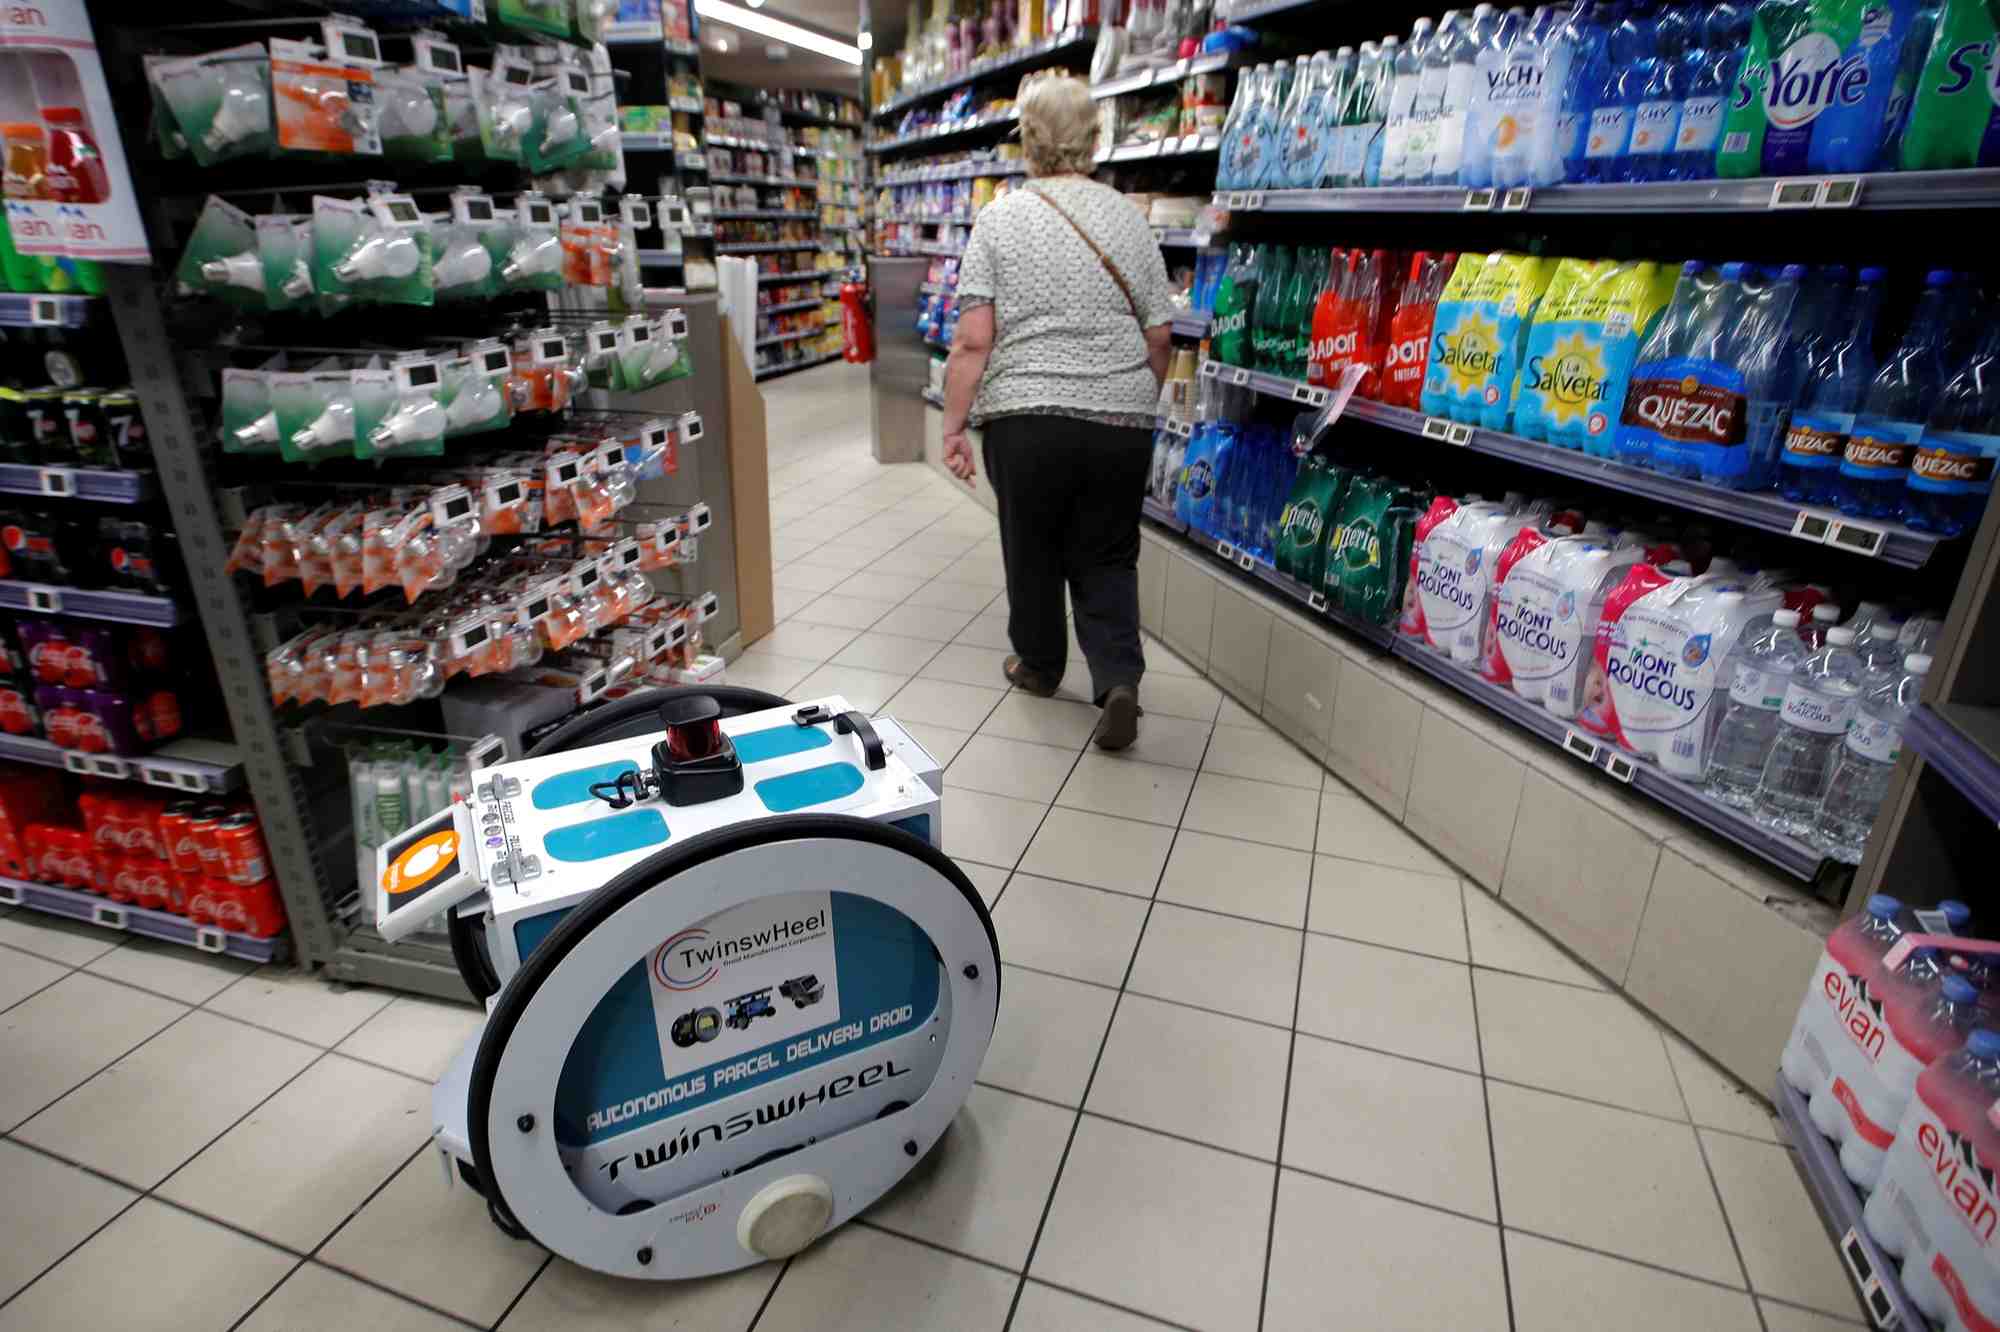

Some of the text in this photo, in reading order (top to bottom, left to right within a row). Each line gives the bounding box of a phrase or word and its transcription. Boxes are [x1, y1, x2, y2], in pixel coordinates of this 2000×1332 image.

[1385, 336, 1429, 368] DOIT
[1524, 355, 1612, 401] Salvetat
[1496, 612, 1568, 661] ROUCOUS
[1607, 656, 1696, 712] ROUCOUS
[680, 909, 826, 968] TwinswHeel
[1823, 969, 1886, 1063] evian
[713, 1051, 780, 1089] PARCEL
[786, 1020, 864, 1062] DELIVERY
[870, 1005, 913, 1033] DROID
[1917, 1122, 1998, 1241] evian
